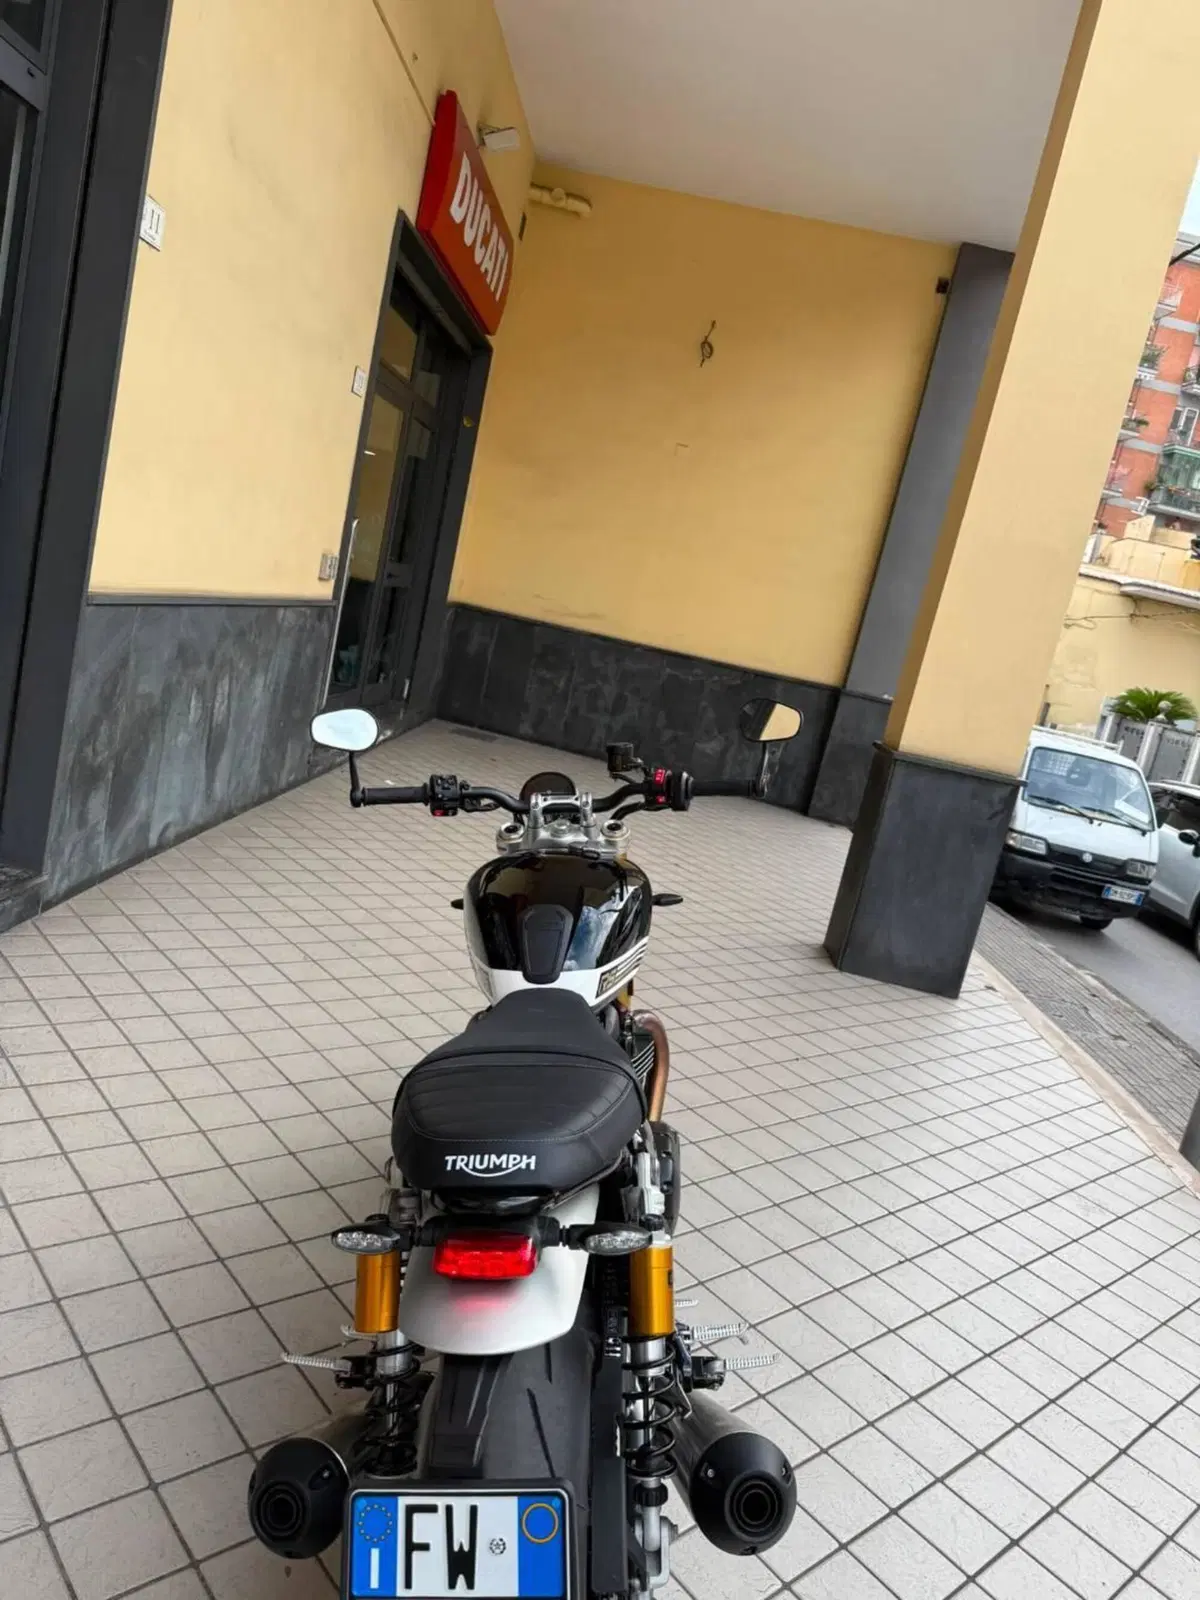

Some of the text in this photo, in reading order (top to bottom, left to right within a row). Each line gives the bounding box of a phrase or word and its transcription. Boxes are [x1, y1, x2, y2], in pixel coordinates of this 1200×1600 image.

[450, 151, 509, 302] DUCATI
[445, 1153, 537, 1177] TRIUMPH
[404, 1504, 478, 1590] FW
